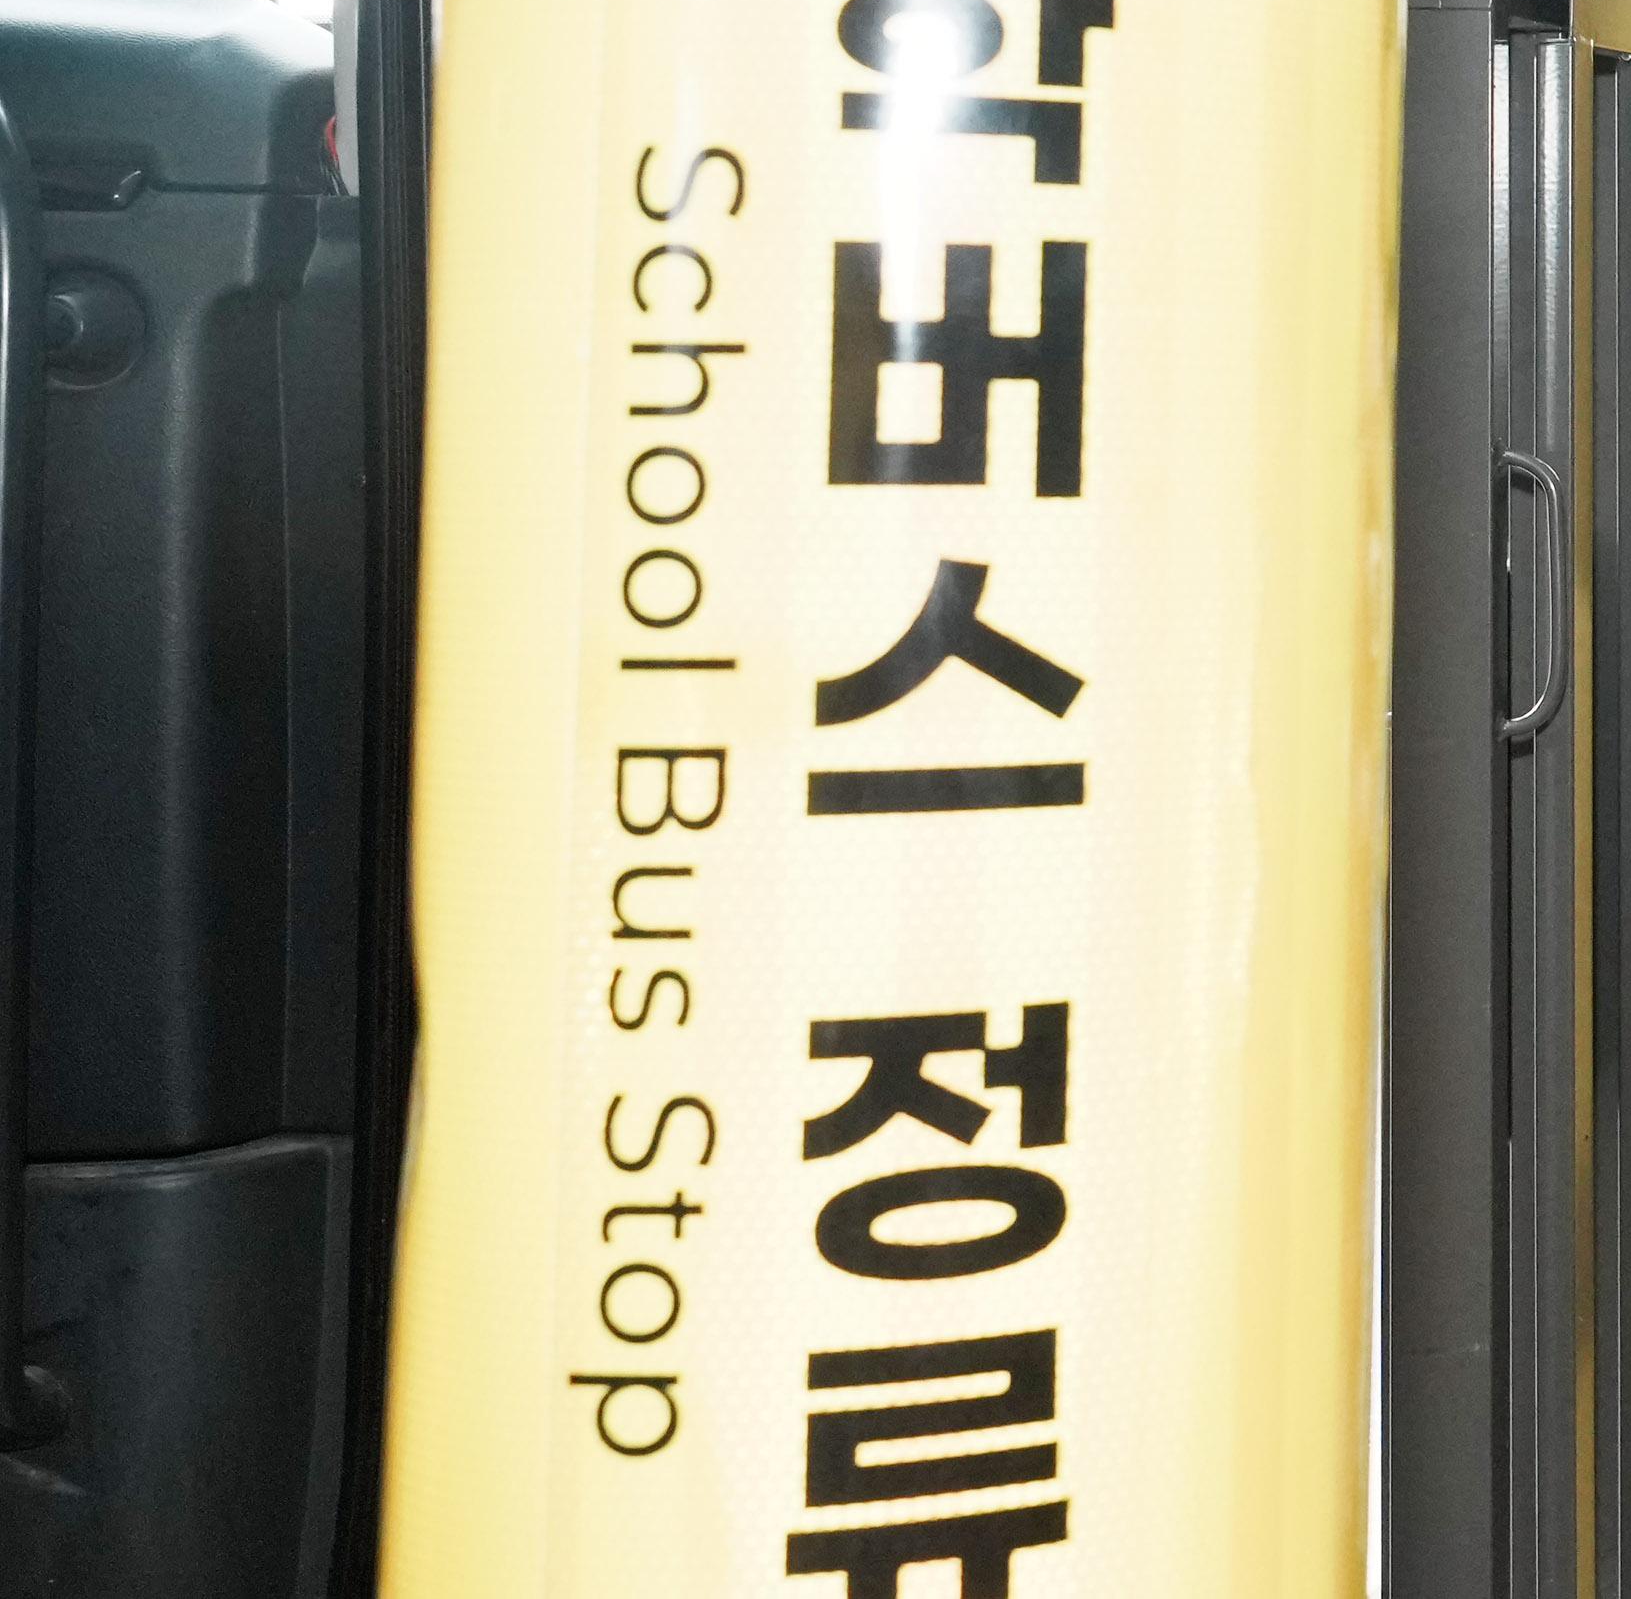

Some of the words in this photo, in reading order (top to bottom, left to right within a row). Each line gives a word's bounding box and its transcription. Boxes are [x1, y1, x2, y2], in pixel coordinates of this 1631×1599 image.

[620, 147, 745, 671] School
[609, 748, 726, 1031] Bus
[569, 1095, 716, 1457] Stop
